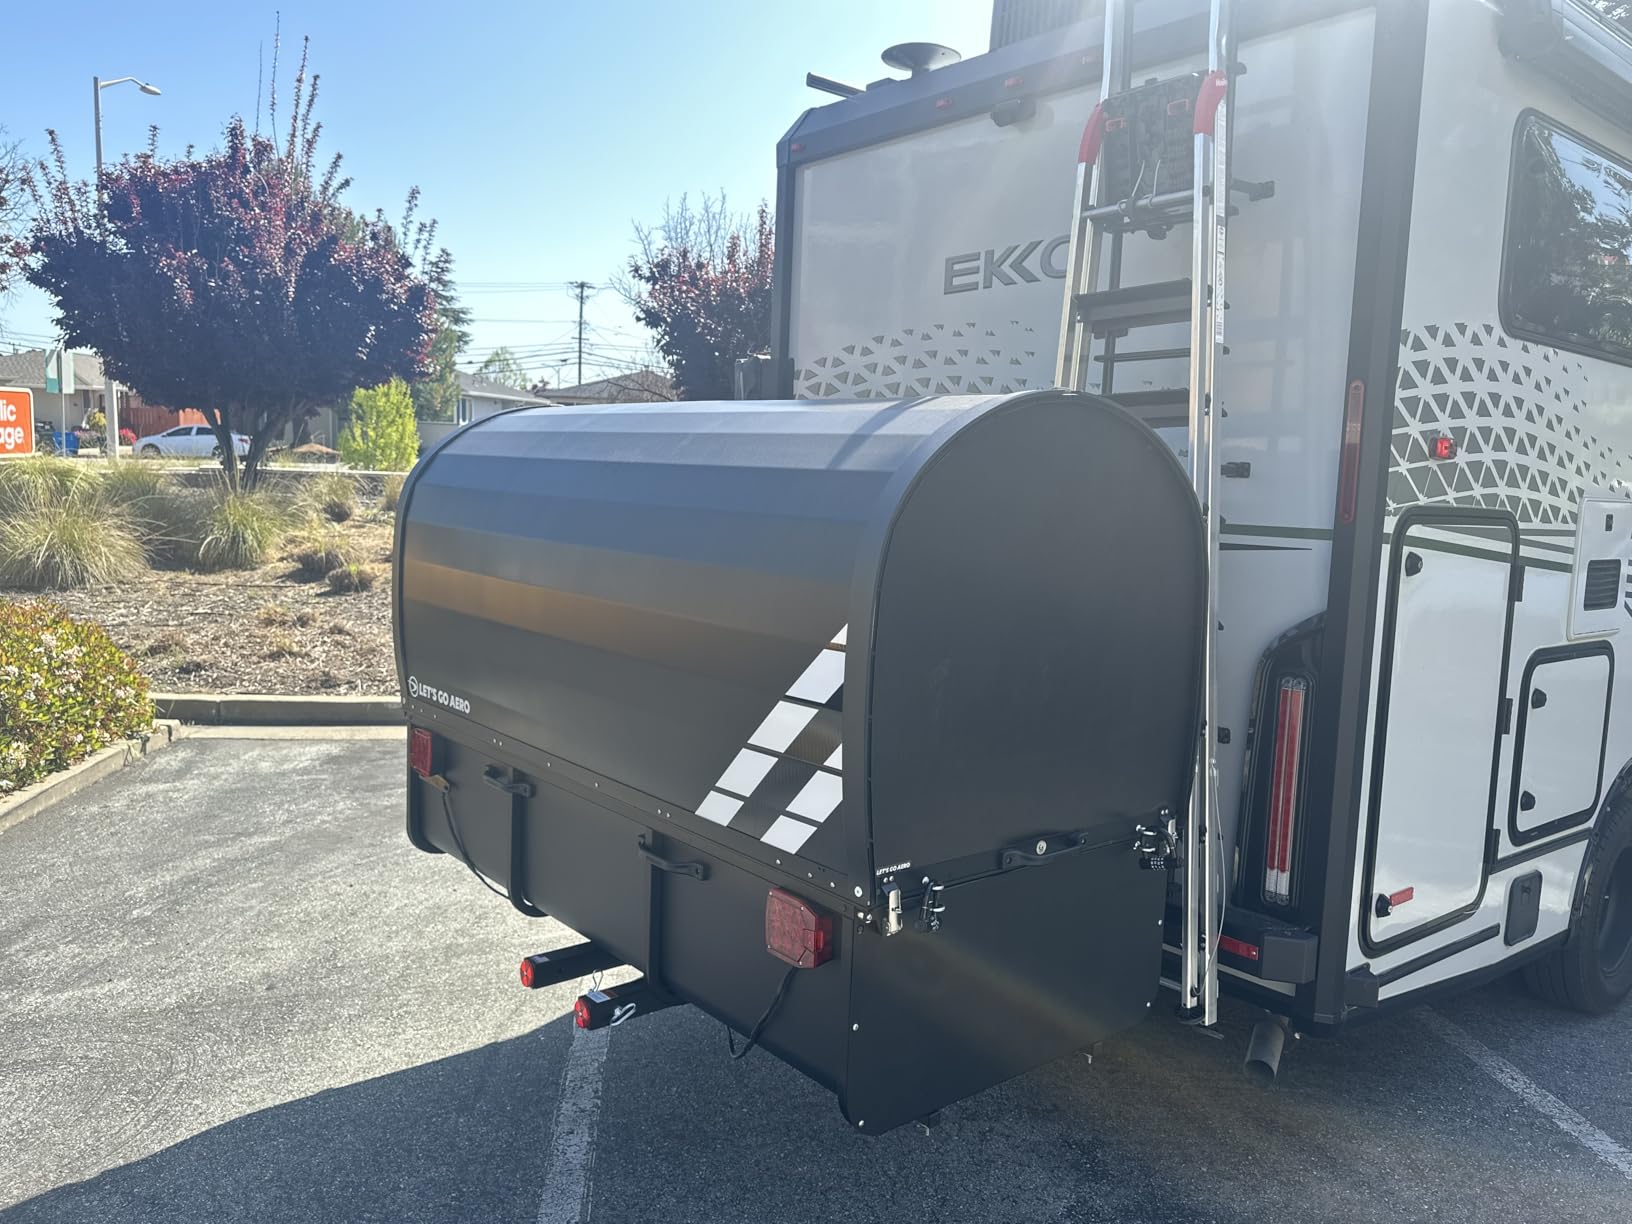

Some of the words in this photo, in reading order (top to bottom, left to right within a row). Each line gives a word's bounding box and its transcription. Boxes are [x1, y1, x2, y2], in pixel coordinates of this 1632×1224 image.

[419, 682, 437, 701] LET'S
[438, 690, 449, 706] GO
[449, 695, 471, 714] AERO
[876, 867, 889, 876] LET'S
[889, 865, 897, 873] GO
[897, 862, 911, 871] AERO
